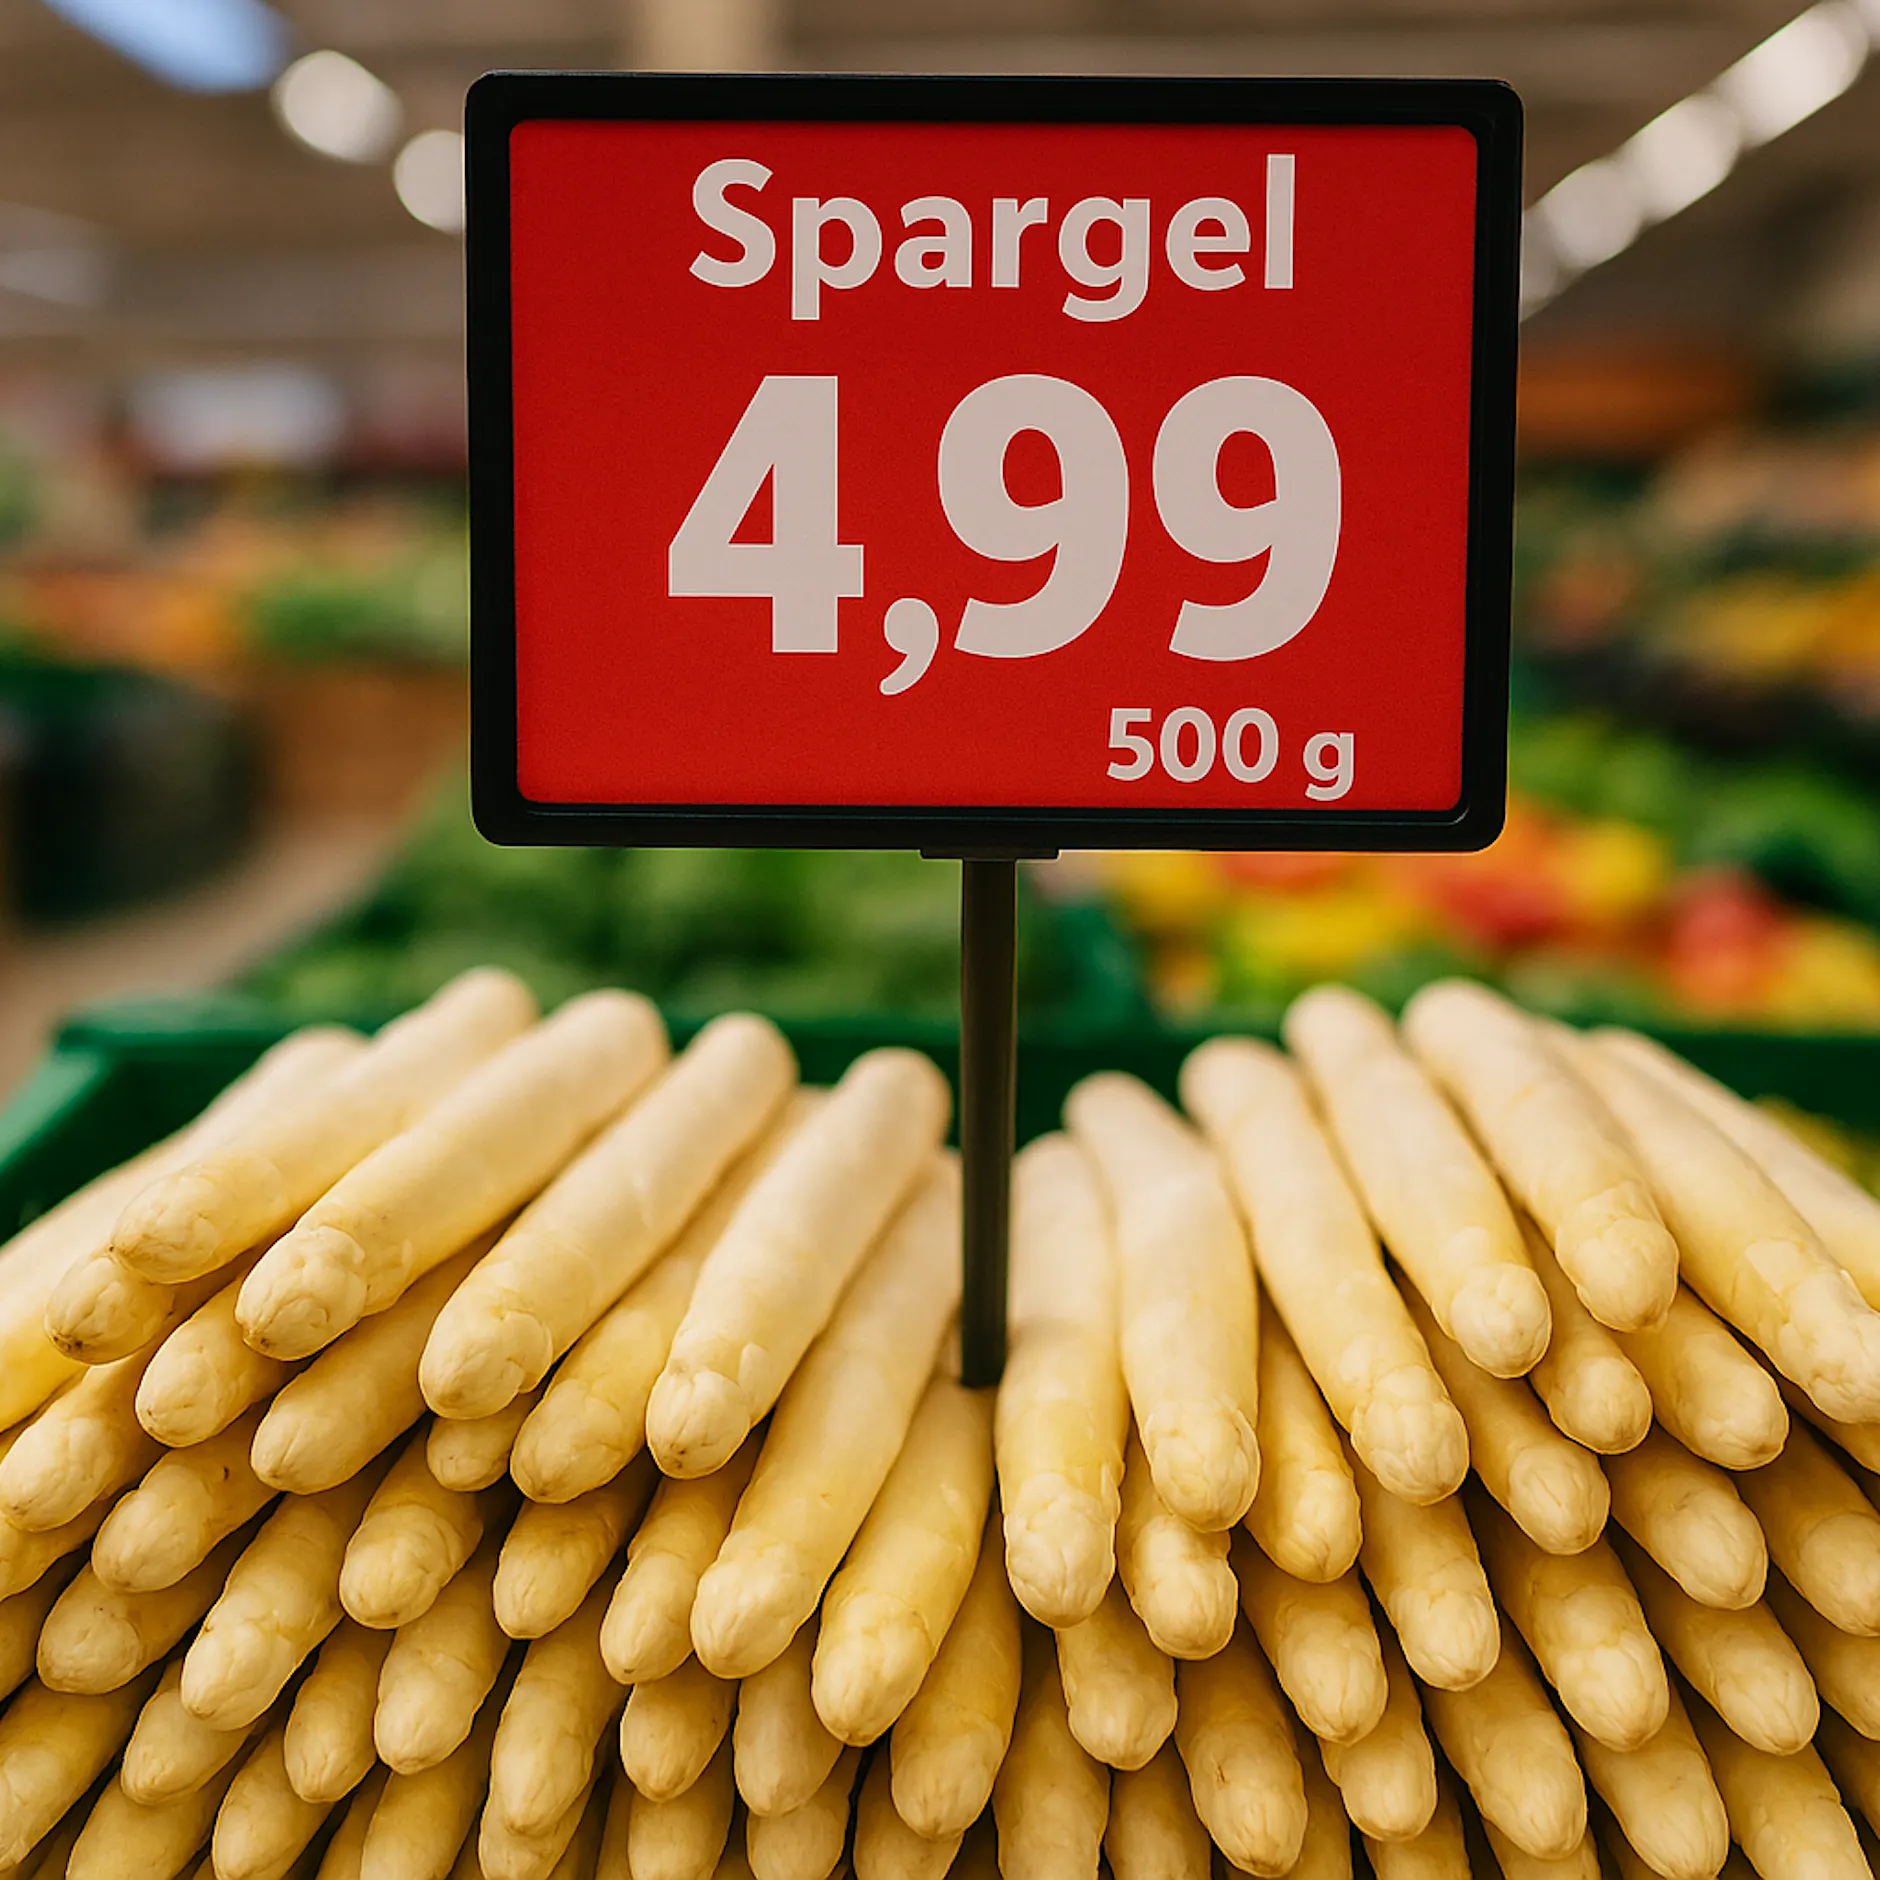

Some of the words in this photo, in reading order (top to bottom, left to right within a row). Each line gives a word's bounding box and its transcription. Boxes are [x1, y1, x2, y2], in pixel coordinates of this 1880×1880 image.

[689, 153, 1296, 323] Spargel
[667, 373, 1342, 696] 4,99
[1106, 706, 1279, 784] 500
[1302, 731, 1355, 802] g
